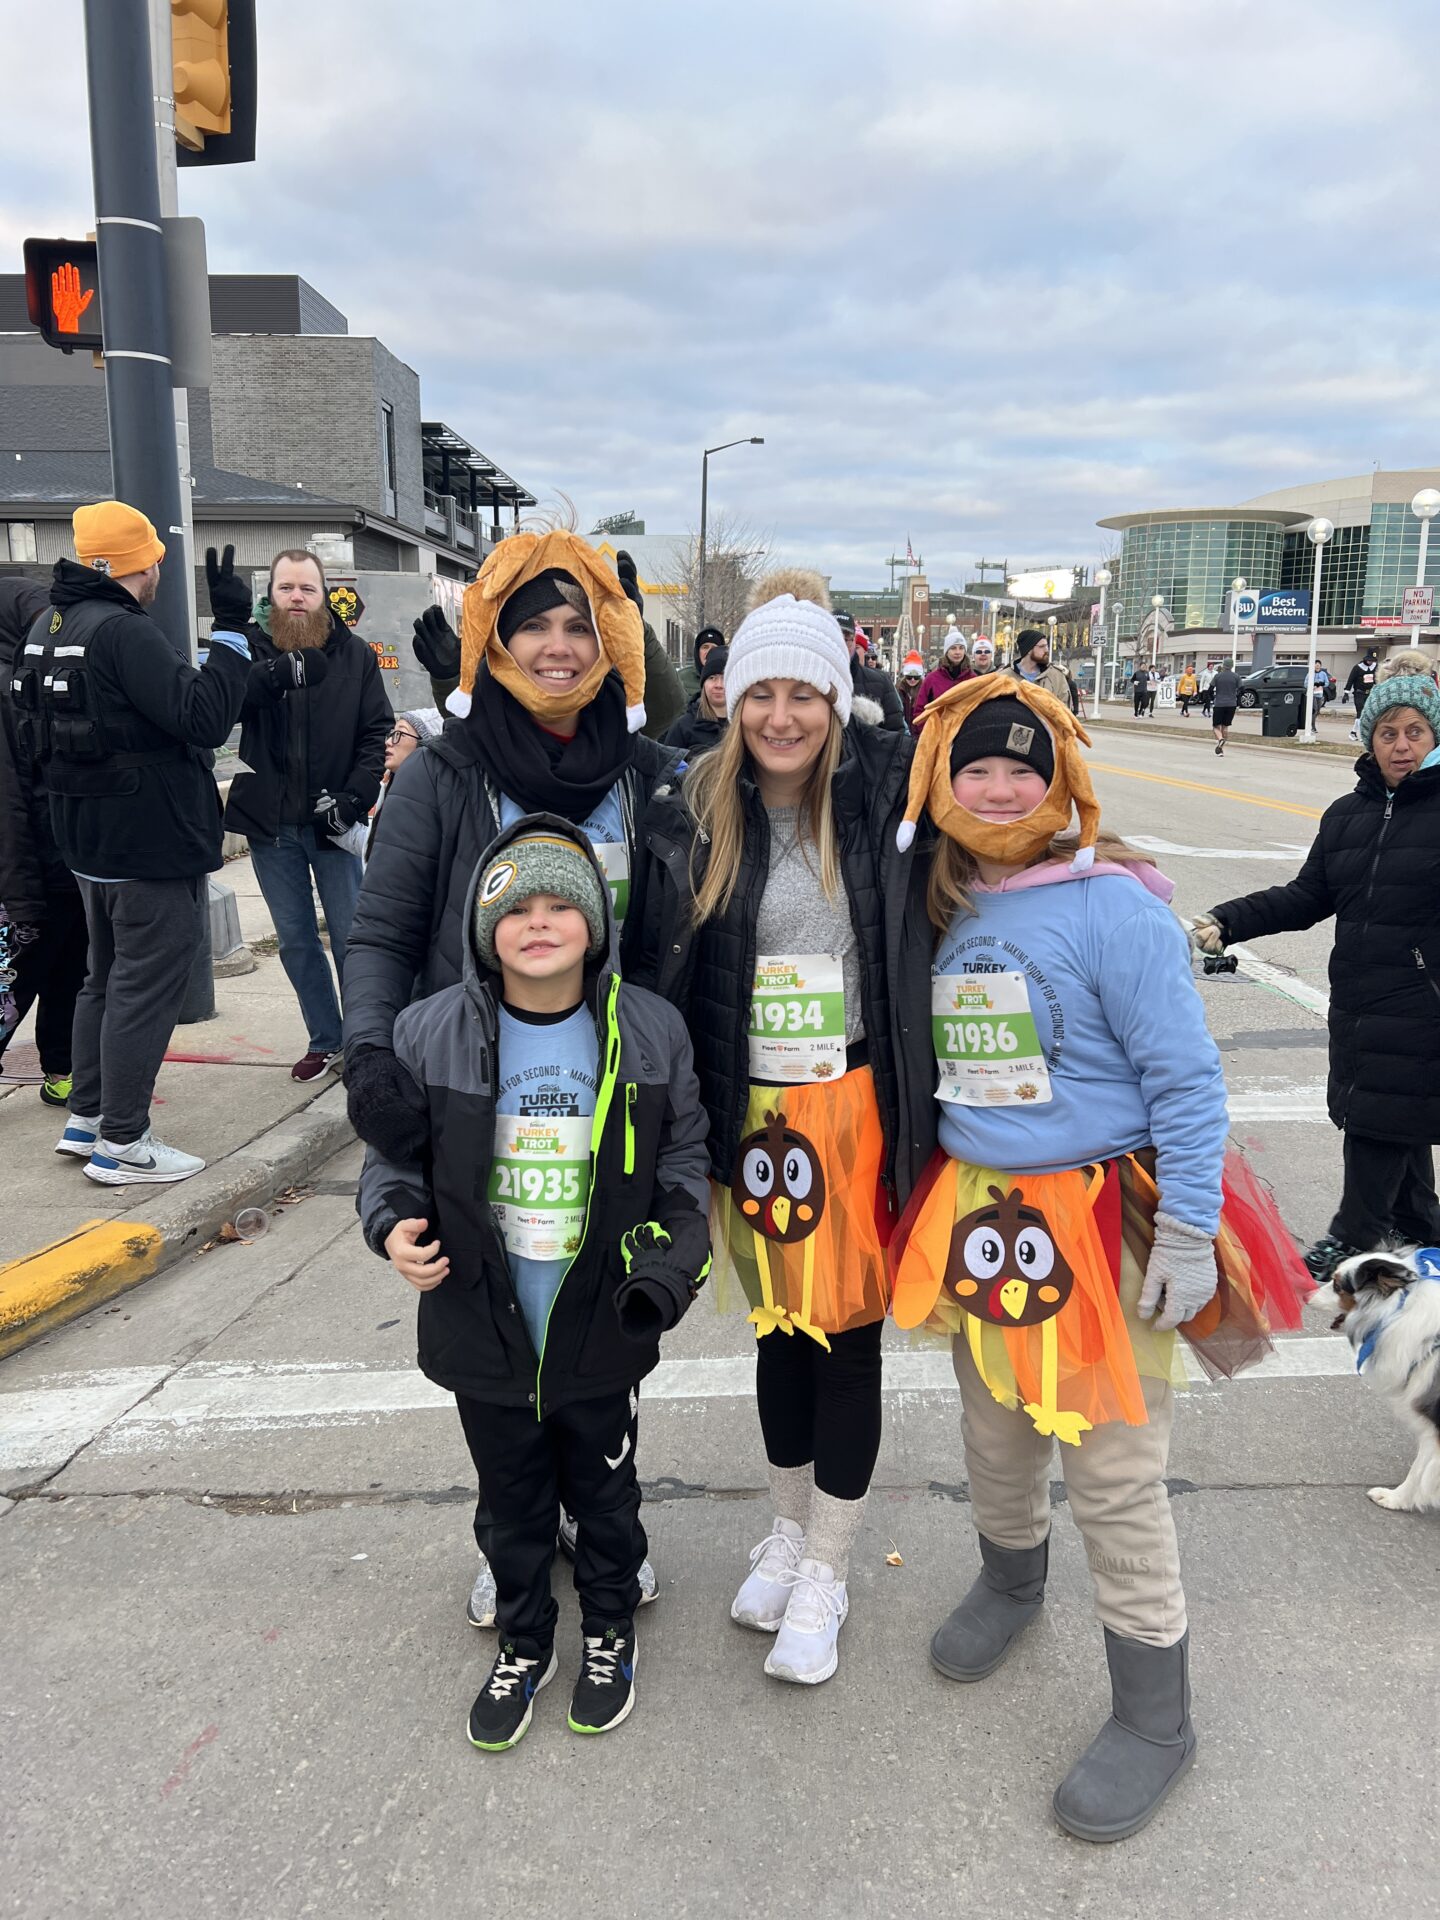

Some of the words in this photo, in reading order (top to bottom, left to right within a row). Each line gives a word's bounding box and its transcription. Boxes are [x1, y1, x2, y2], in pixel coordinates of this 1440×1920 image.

[1272, 596, 1296, 607] Best
[1093, 636, 1106, 645] 25
[1160, 687, 1173, 700] 10
[757, 964, 797, 974] TURKEY
[962, 962, 1007, 974] TURKEY
[761, 975, 793, 985] TROT
[939, 953, 955, 973] ROOM
[955, 942, 966, 956] FOR
[967, 935, 997, 948] SECONDS
[1002, 940, 1028, 965] MAKING
[1024, 961, 1047, 986] ROOM
[1041, 985, 1057, 1003] FOR
[1049, 1003, 1065, 1040] SECONDS
[956, 984, 986, 993] TURKEY
[961, 995, 984, 1004] TROT
[943, 1021, 1018, 1054] 21936
[817, 1042, 835, 1051] MILE
[1015, 1062, 1035, 1072] MILE
[506, 1073, 523, 1090] FOR
[523, 1065, 561, 1081] SECONDS
[519, 1092, 579, 1106] TURKEY
[527, 1107, 571, 1117] TROT
[516, 1127, 559, 1137] TURKEY
[521, 1138, 554, 1149] TROT
[495, 1164, 580, 1202] 21935
[564, 1215, 569, 1224] 2
